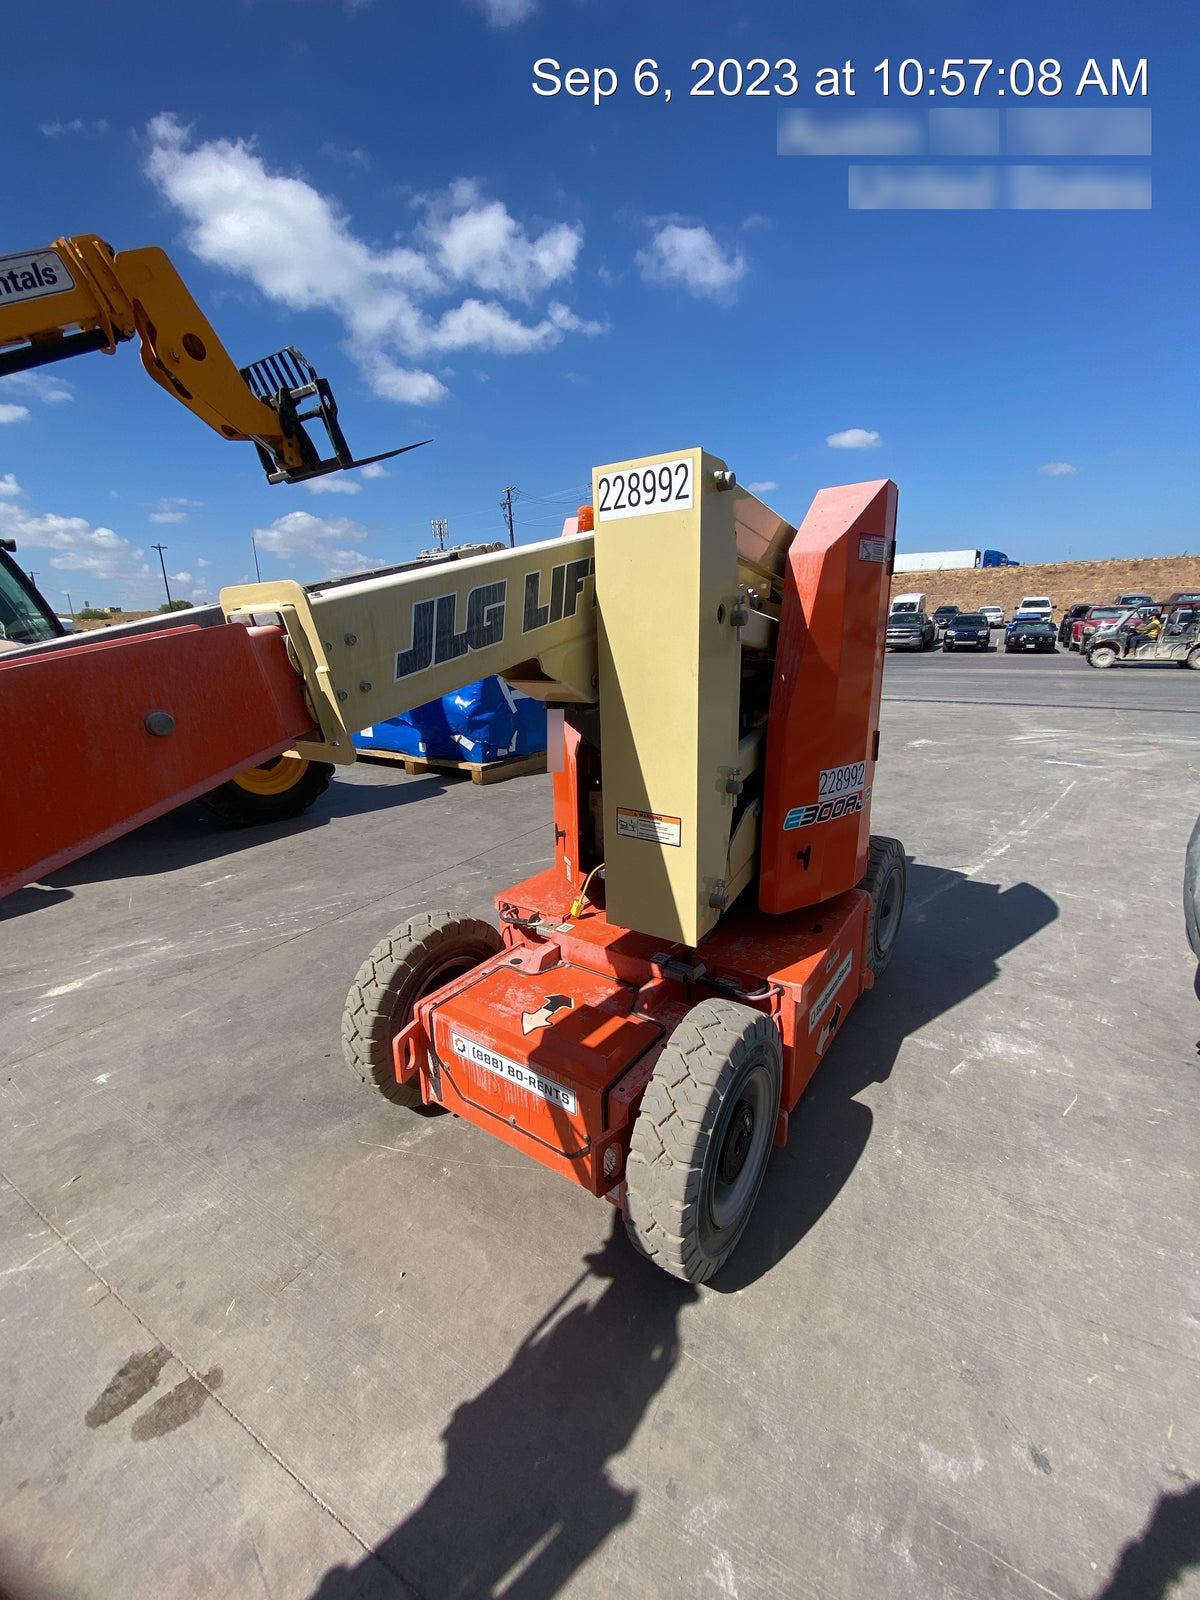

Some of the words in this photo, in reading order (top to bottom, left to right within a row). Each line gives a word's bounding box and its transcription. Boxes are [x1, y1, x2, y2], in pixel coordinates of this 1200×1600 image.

[598, 463, 690, 512] 228992
[394, 577, 508, 683] JLG
[521, 555, 595, 635] LIF
[818, 763, 865, 796] 228992
[472, 1046, 504, 1072] (888)
[507, 1065, 571, 1105] 80-RENTS
